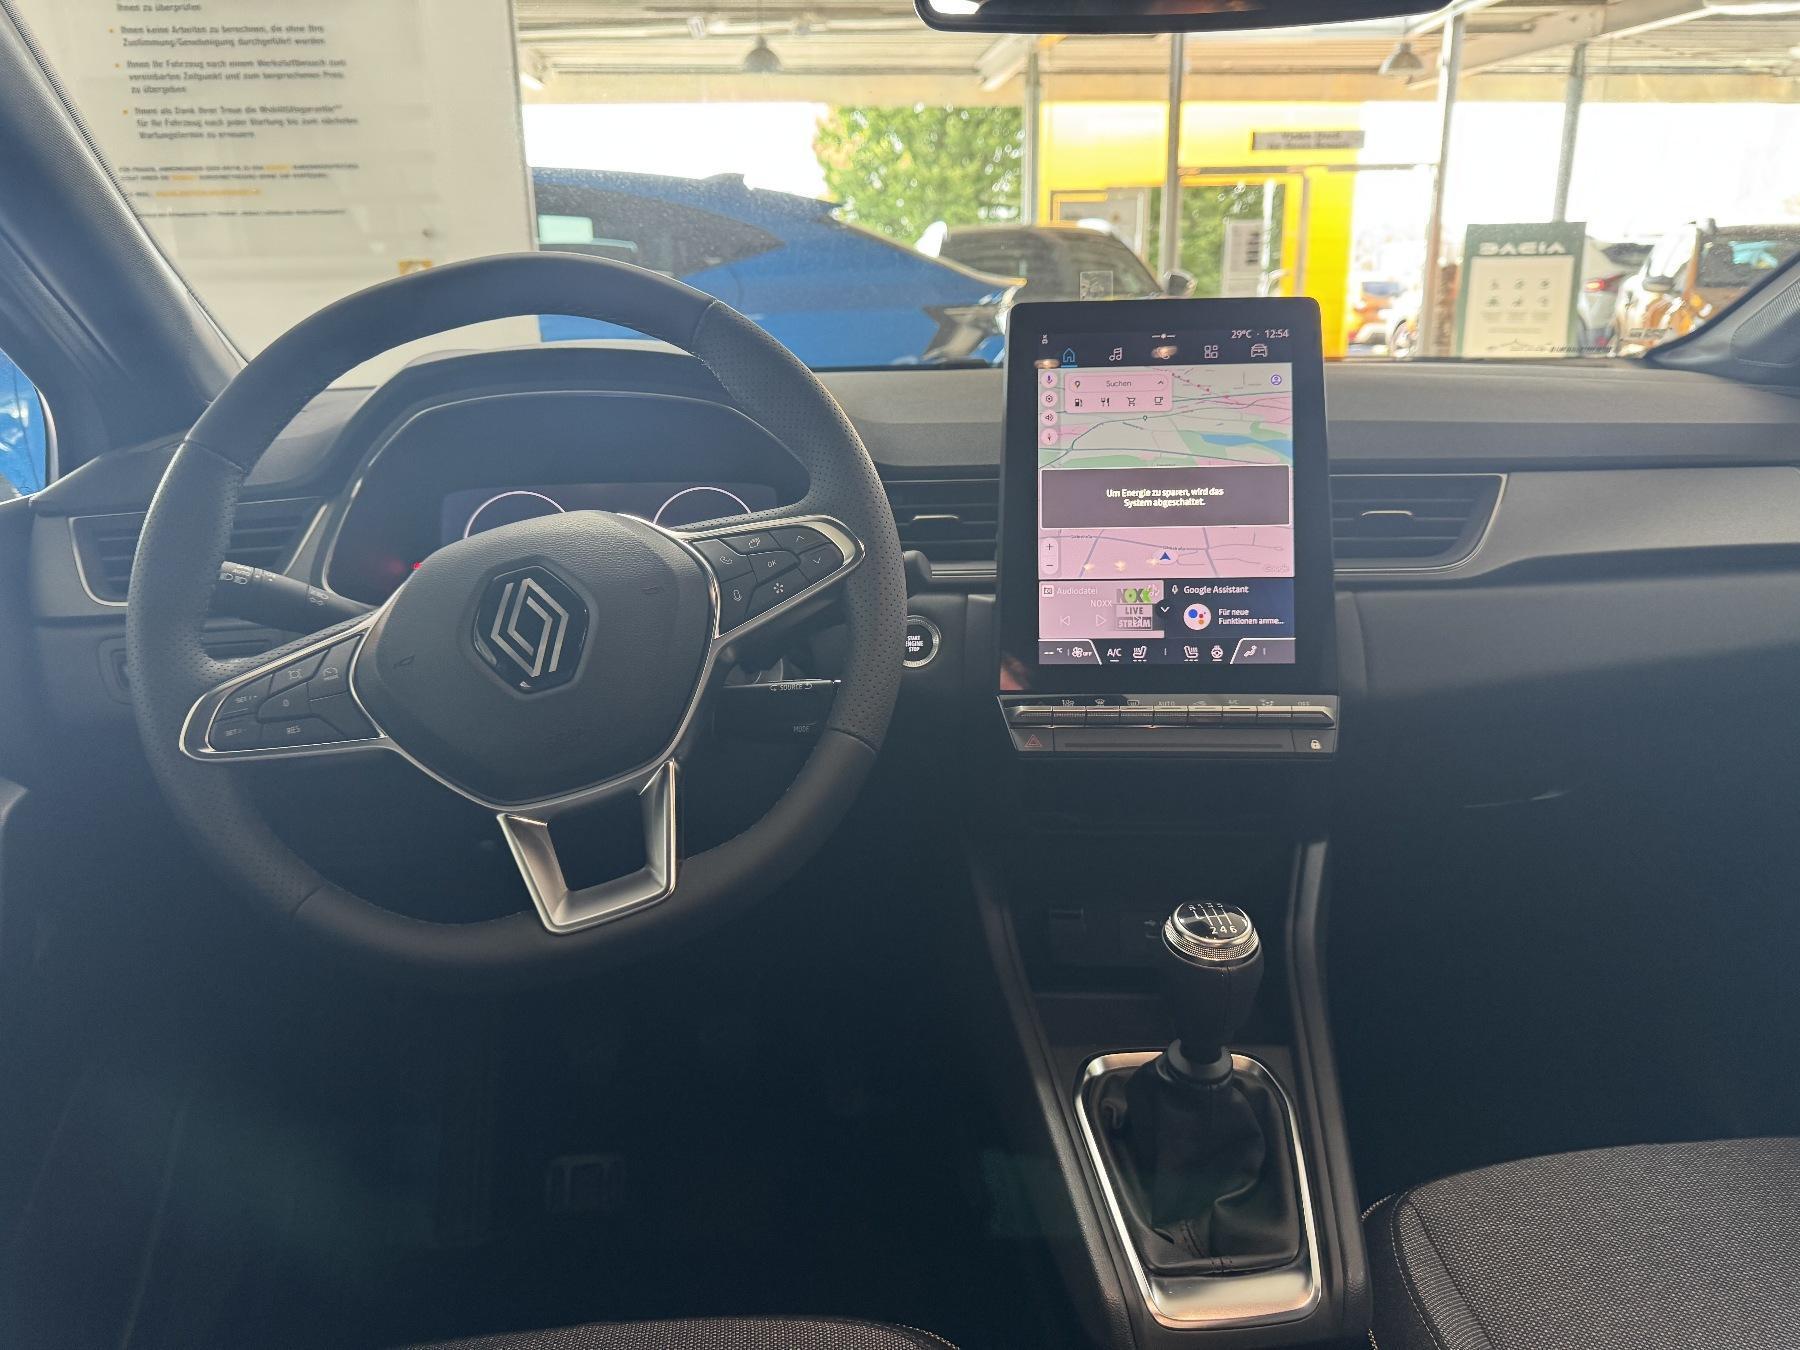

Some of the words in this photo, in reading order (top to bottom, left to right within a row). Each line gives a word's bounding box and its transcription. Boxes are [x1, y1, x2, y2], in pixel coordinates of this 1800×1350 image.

[1264, 328, 1290, 338] 12:54
[1105, 378, 1132, 389] Suchen
[1106, 488, 1120, 498] Um
[1121, 488, 1151, 498] Energie
[1151, 489, 1161, 497] zu
[1161, 488, 1191, 498] sparen,
[1190, 487, 1208, 496] wird
[1208, 487, 1225, 496] das
[1123, 498, 1152, 508] System
[1152, 497, 1206, 508] abgeschaltet.
[767, 560, 777, 568] OK
[1183, 585, 1211, 596] Google
[1212, 585, 1249, 594] Assistant
[1090, 599, 1113, 608] NOXX
[1125, 606, 1144, 615] LIVE
[1218, 608, 1231, 616] Für
[1118, 617, 1151, 628] STREAM
[1218, 617, 1258, 625] Funktionen
[1107, 648, 1122, 657] A/C
[779, 683, 803, 691] SOURCE
[1210, 926, 1219, 935] 2
[1219, 925, 1228, 934] 4
[1229, 925, 1238, 934] 6
